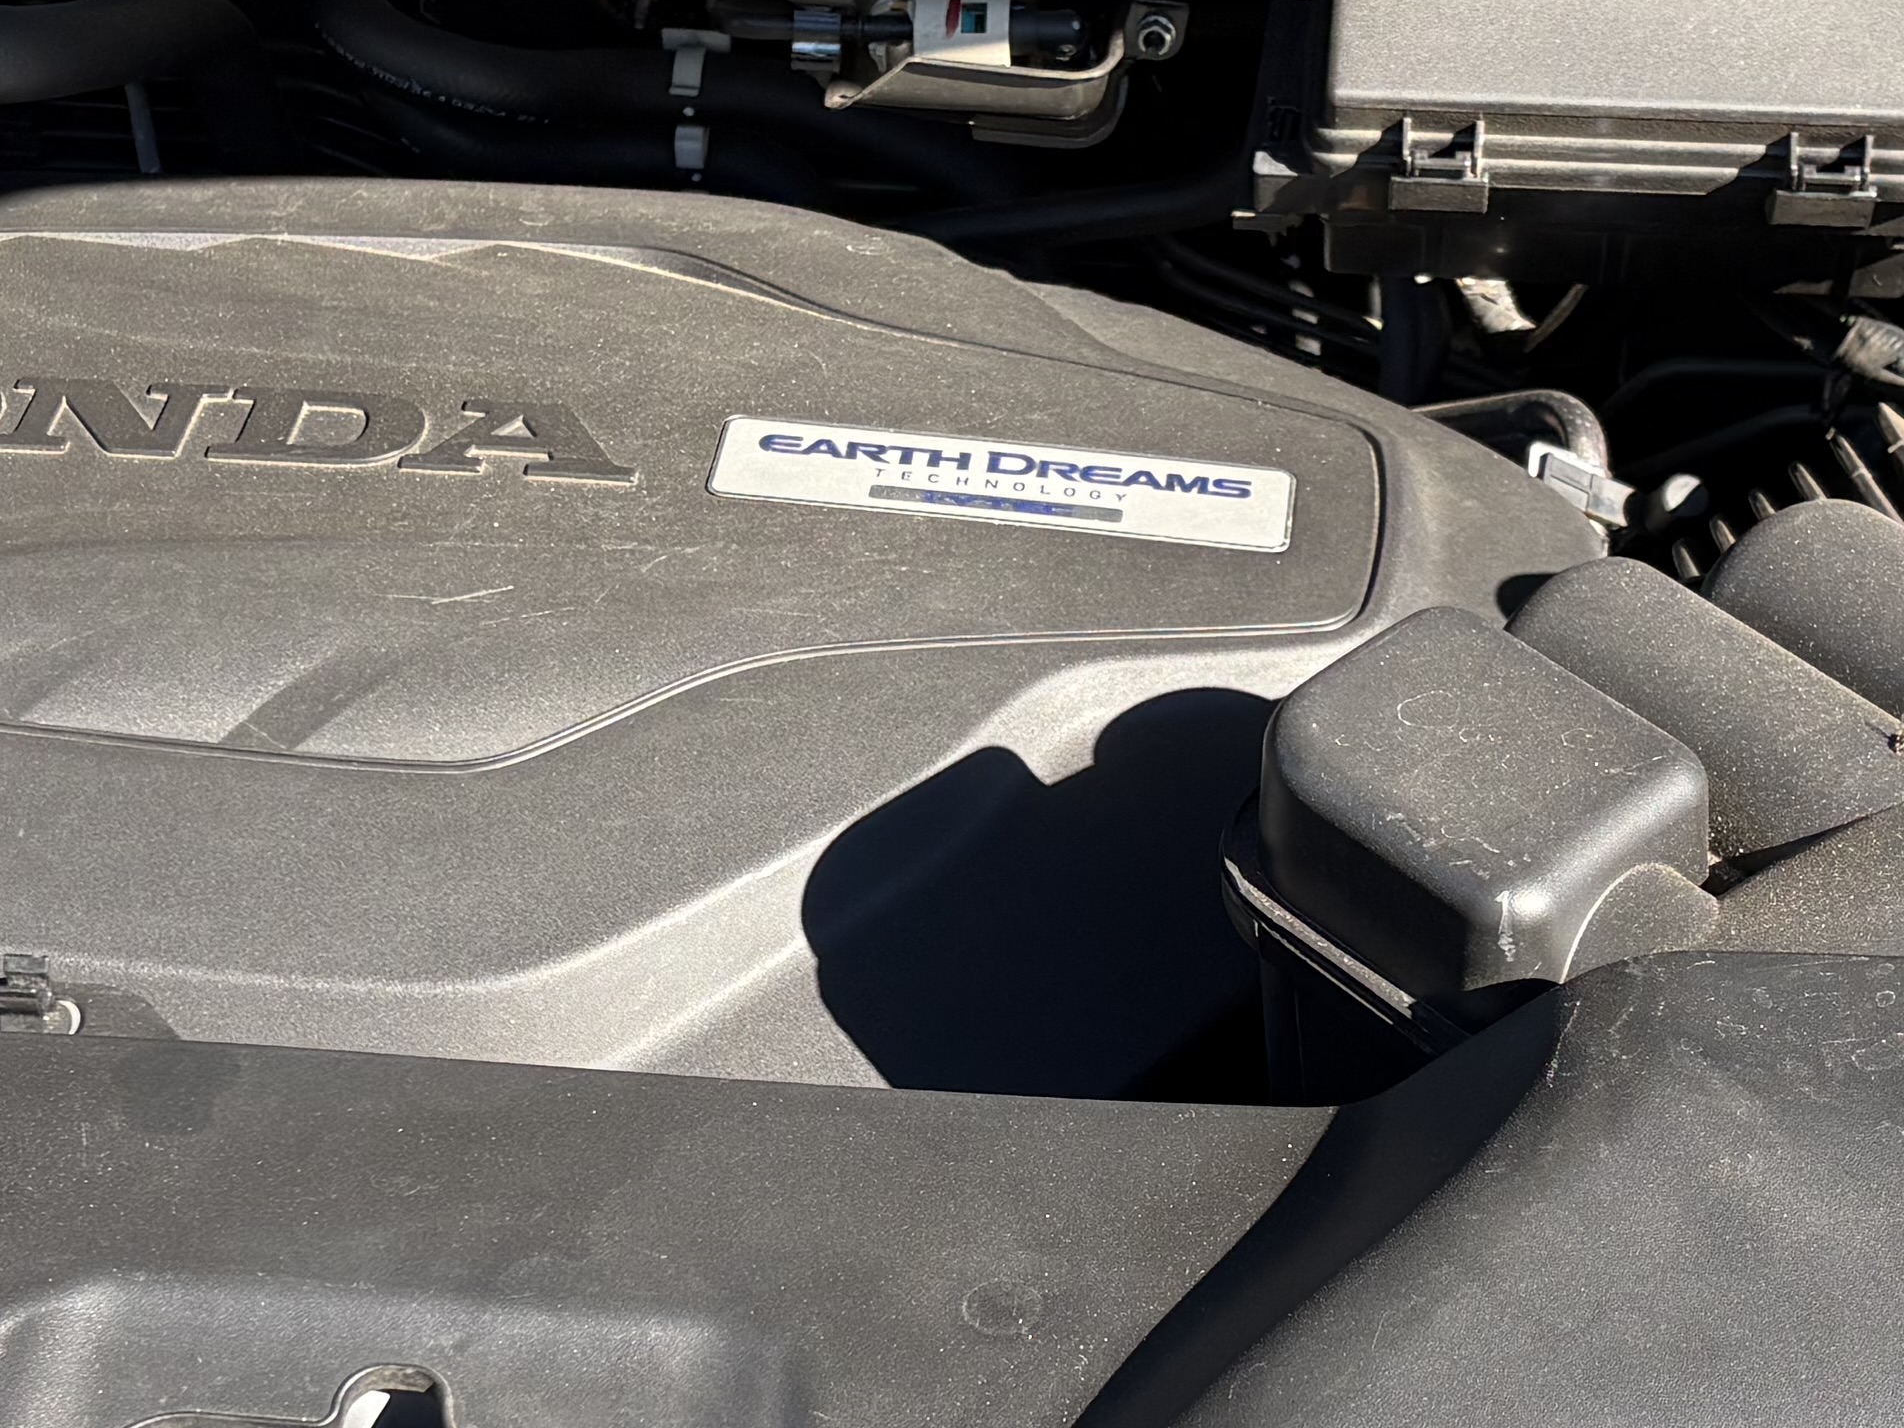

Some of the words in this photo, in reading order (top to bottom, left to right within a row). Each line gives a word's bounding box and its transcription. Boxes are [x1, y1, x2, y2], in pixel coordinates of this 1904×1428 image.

[758, 433, 972, 471] EARTH
[985, 450, 1253, 499] DREAMS
[874, 467, 1128, 503] TECHNOLOGY
